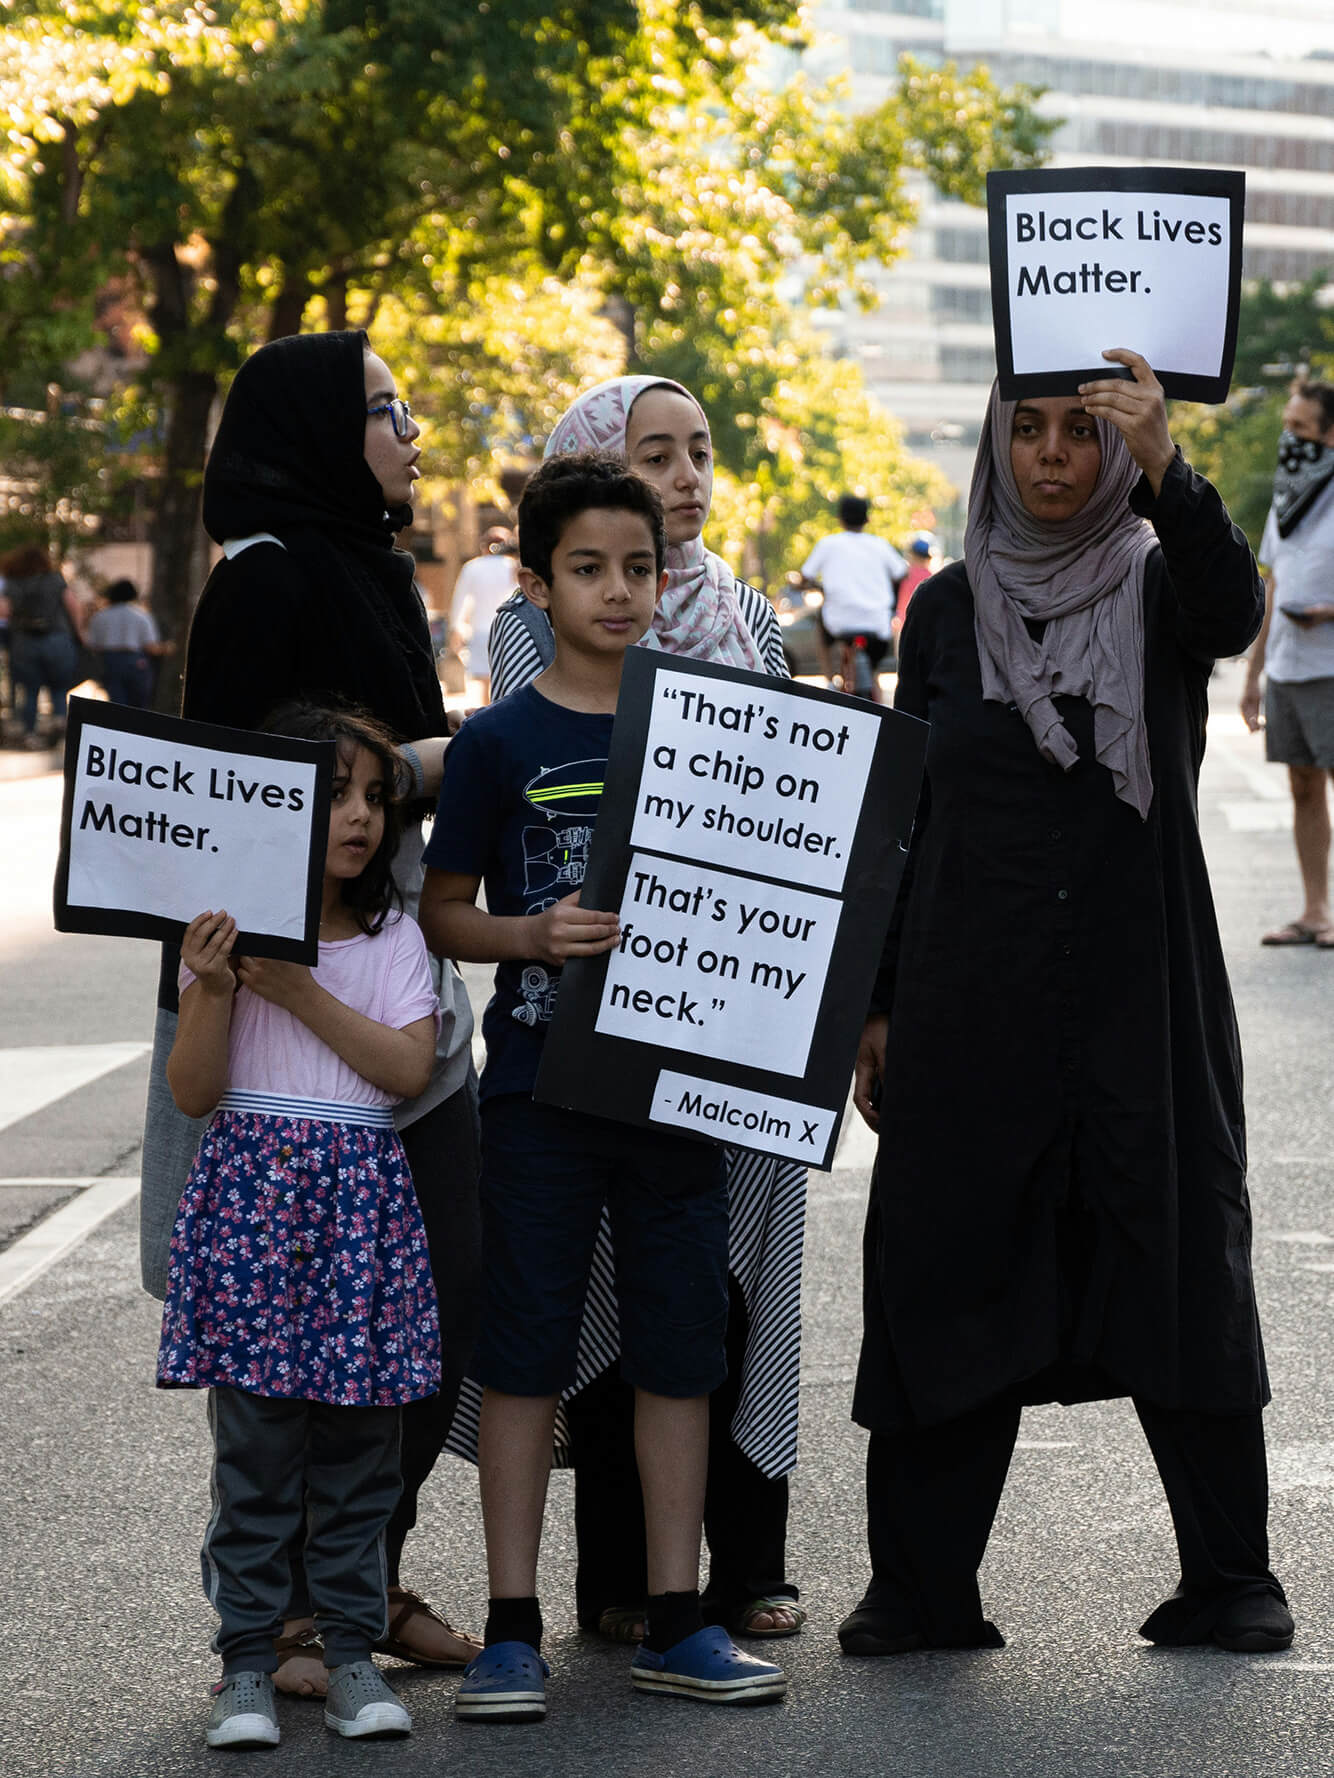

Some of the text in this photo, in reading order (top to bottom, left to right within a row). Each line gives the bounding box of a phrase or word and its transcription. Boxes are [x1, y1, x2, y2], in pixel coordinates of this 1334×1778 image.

[1017, 210, 1221, 245] Black Lives
[1017, 263, 1151, 296] Matter.
[664, 688, 850, 756] “That’s not
[86, 745, 304, 811] Black Lives
[654, 746, 819, 803] a chip on
[80, 800, 218, 852] Matter.
[644, 795, 840, 858] my shoulder.
[634, 872, 816, 941] That’s your
[619, 923, 806, 999] foot on my
[610, 984, 725, 1026] neck.”
[677, 1092, 790, 1138] Malcolm
[798, 1120, 819, 1145] X
